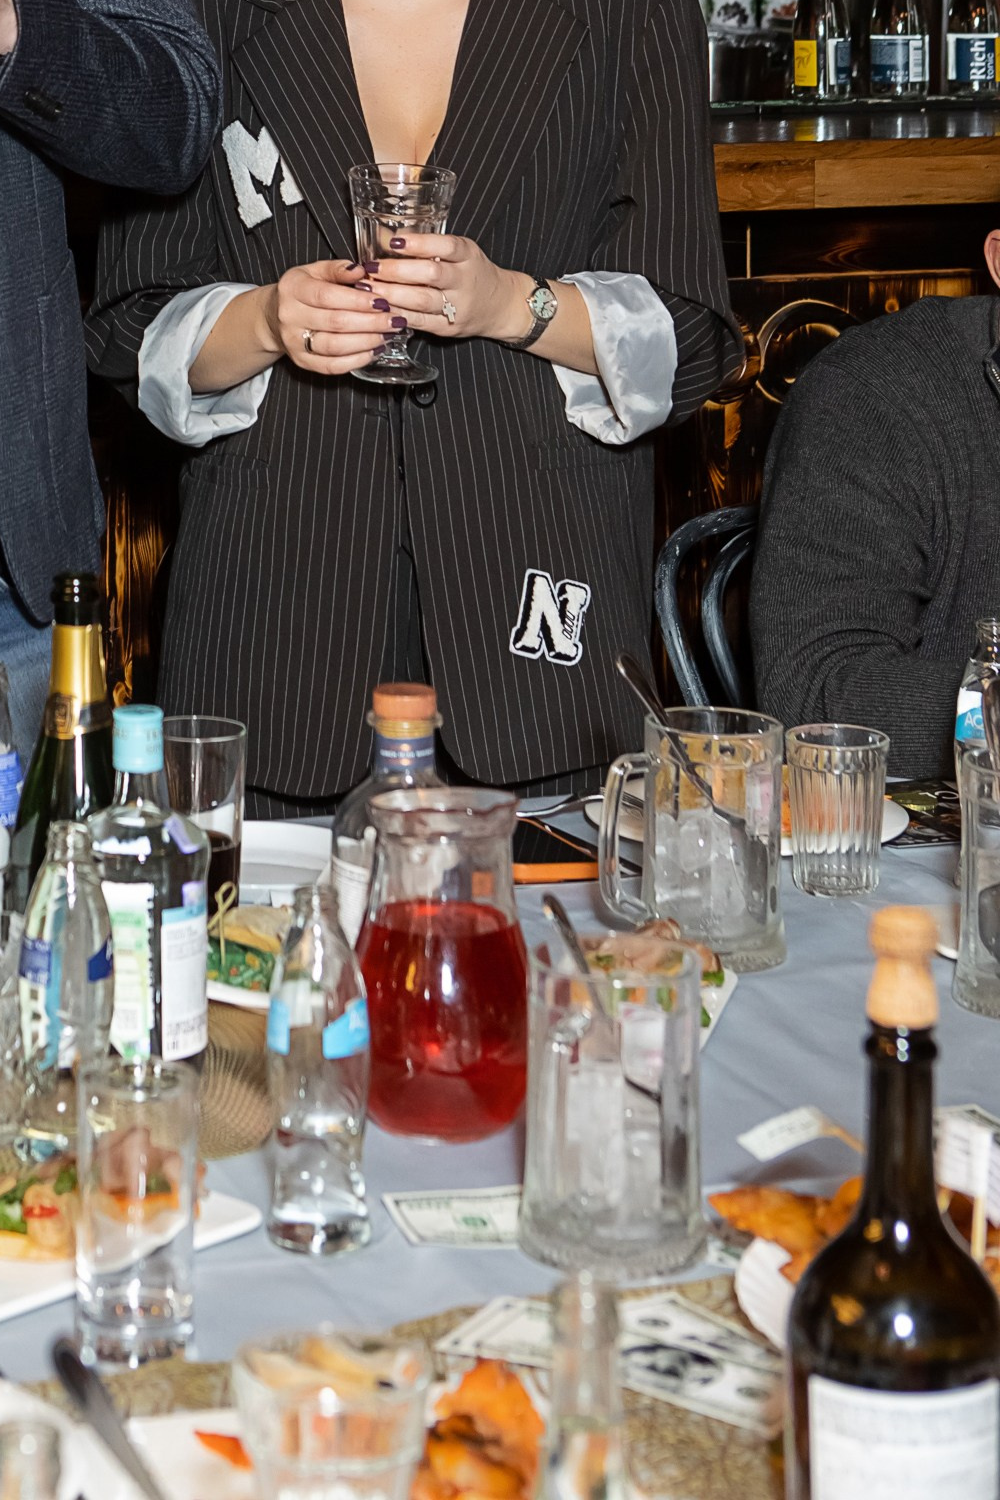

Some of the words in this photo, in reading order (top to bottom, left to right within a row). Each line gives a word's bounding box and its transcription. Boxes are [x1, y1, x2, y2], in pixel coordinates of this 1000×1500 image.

[970, 40, 986, 80] Rich
[986, 52, 994, 80] tonic
[509, 568, 592, 667] N
[964, 711, 984, 730] AQ
